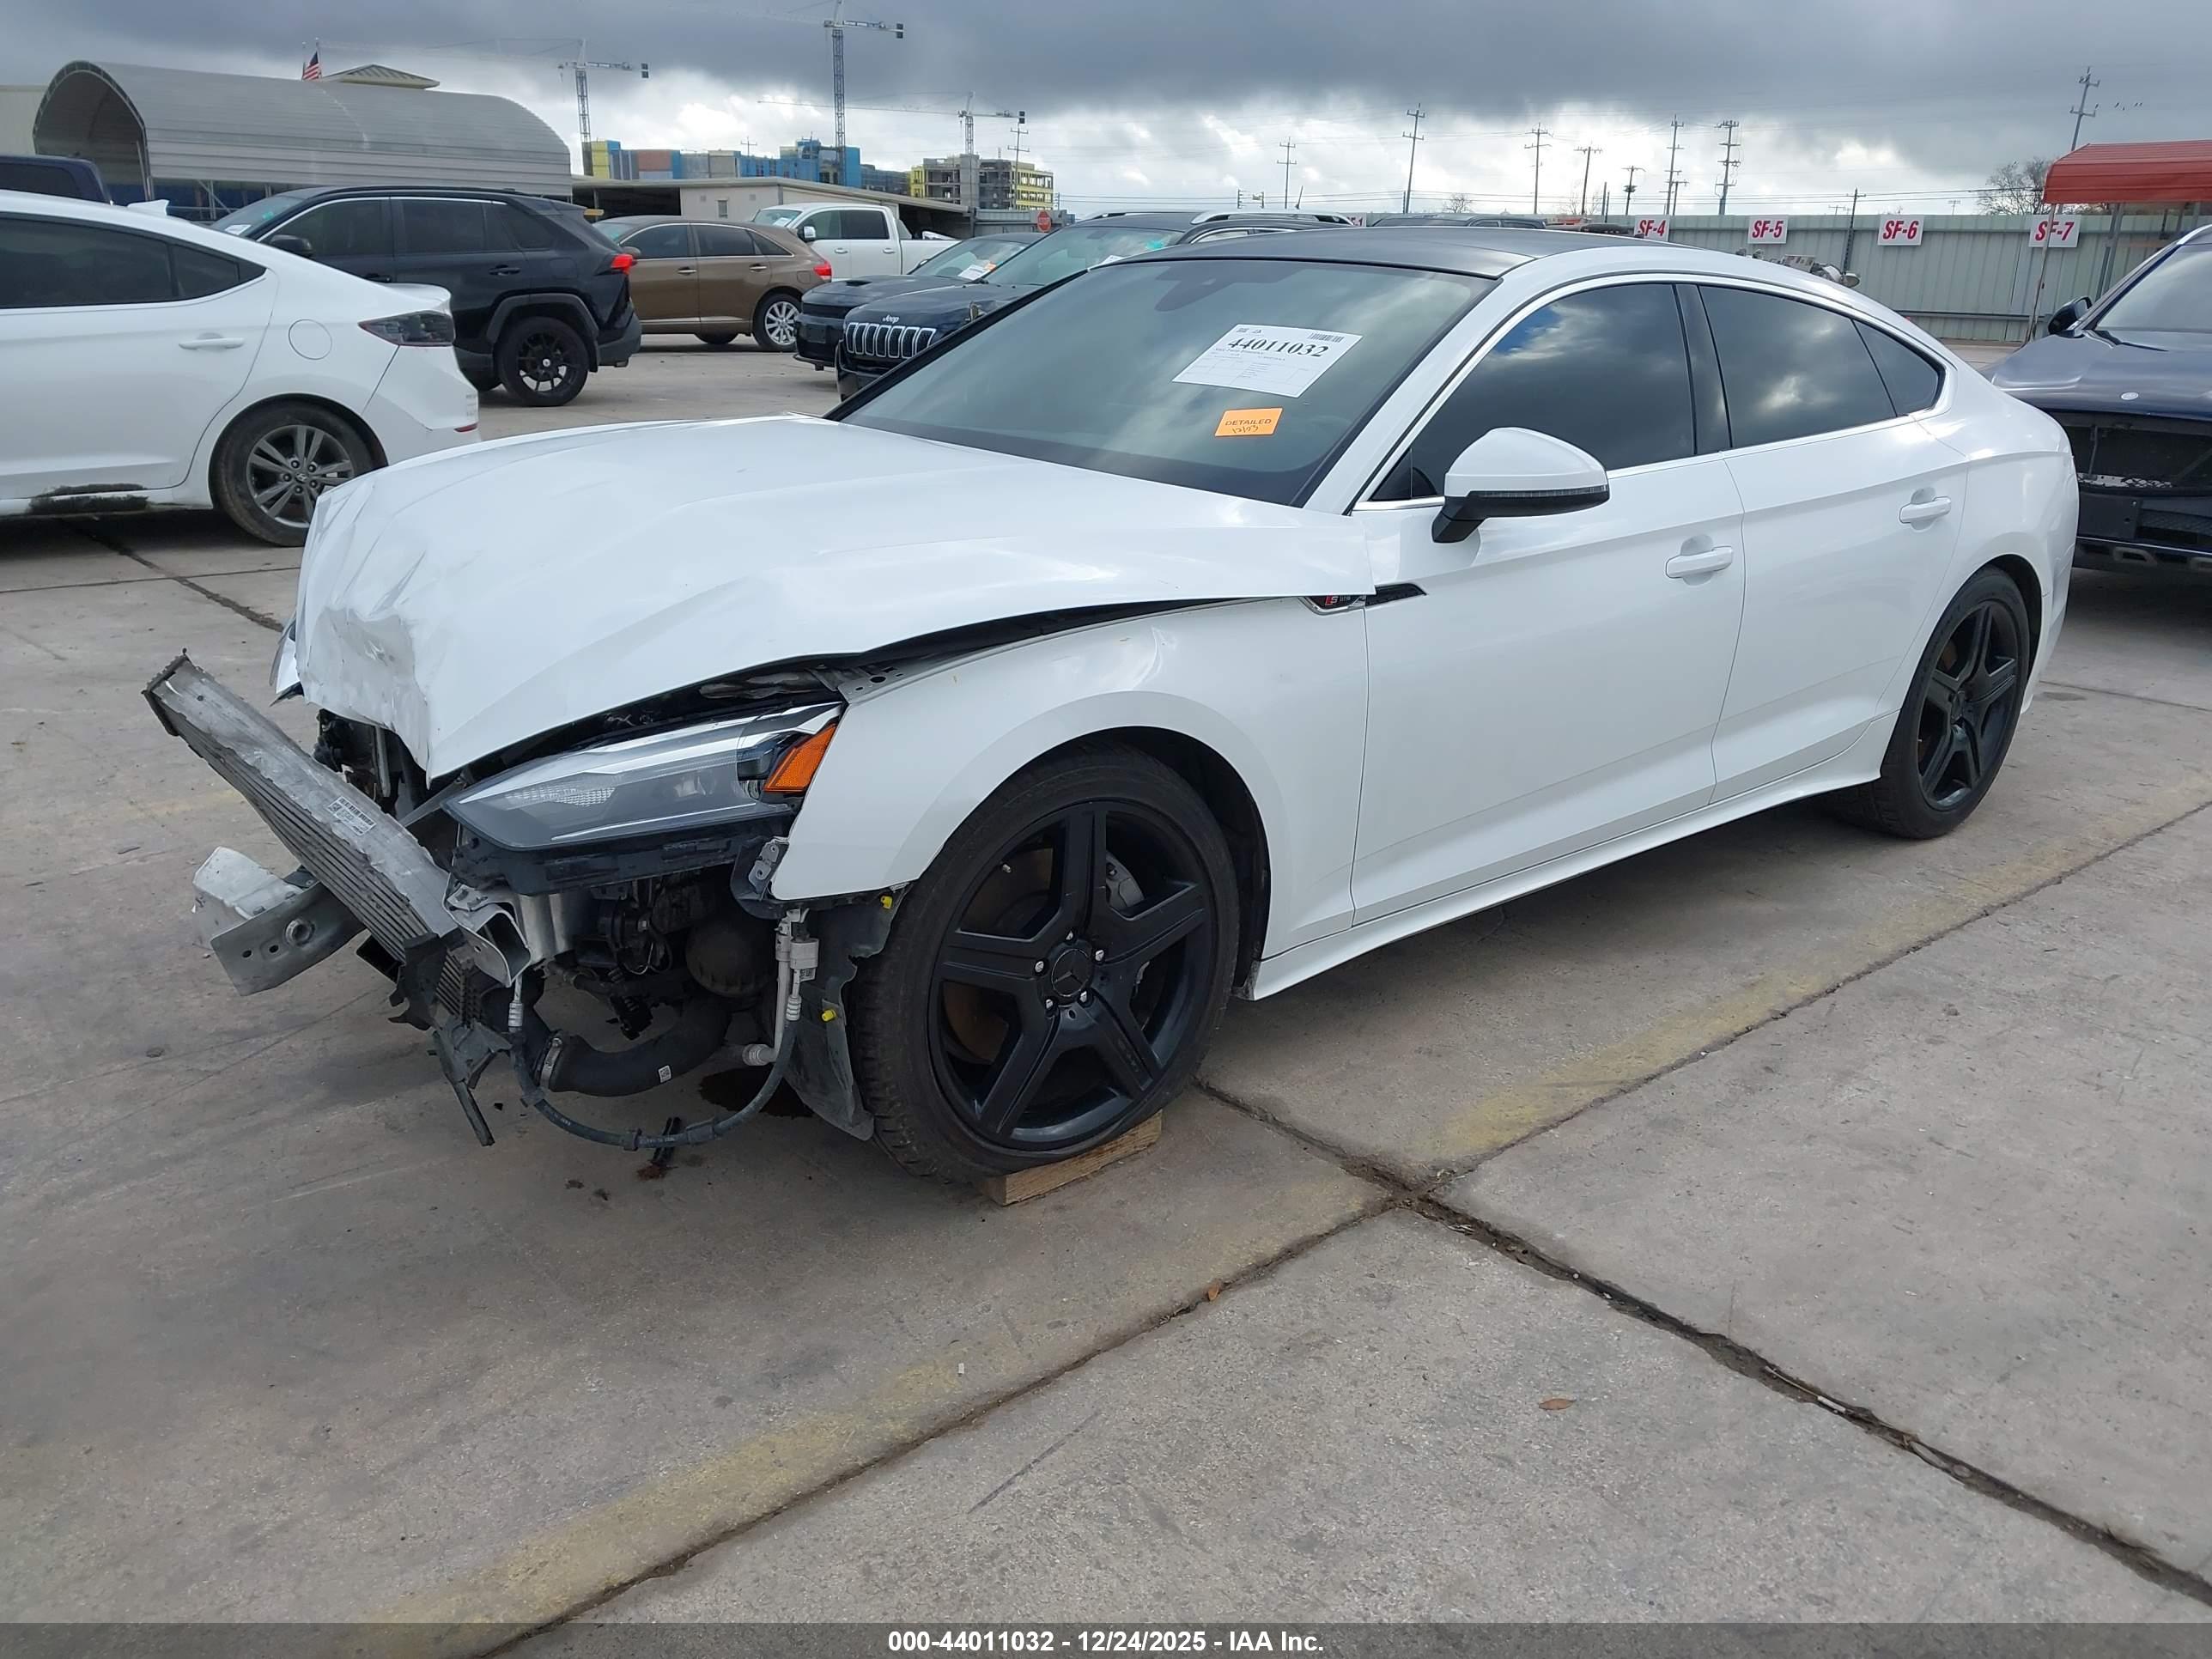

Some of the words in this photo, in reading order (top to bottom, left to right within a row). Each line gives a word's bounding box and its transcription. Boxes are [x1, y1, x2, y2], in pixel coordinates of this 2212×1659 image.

[1638, 219, 1666, 236] SF-4
[1752, 220, 1784, 238] SF-5
[1882, 220, 1919, 240] SF-6
[2035, 220, 2075, 240] SF-7
[882, 314, 900, 324] Jeep
[1228, 337, 1329, 357] 44011032
